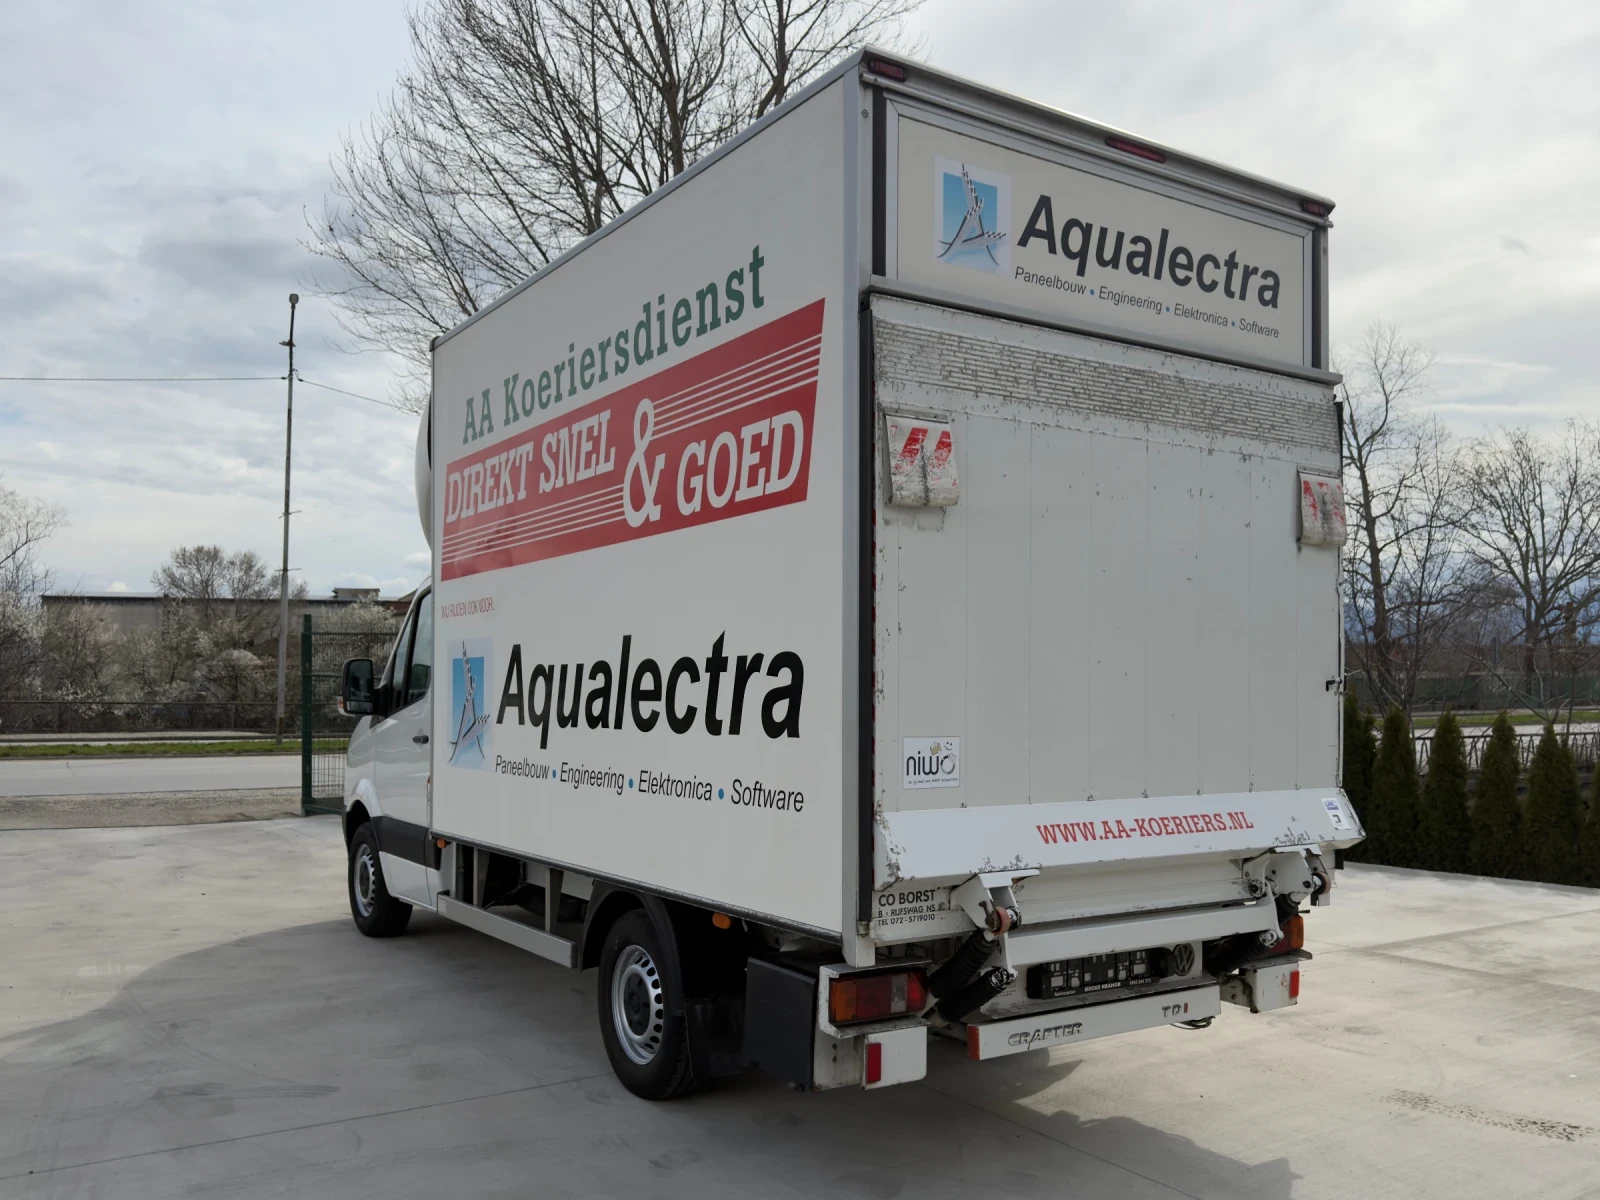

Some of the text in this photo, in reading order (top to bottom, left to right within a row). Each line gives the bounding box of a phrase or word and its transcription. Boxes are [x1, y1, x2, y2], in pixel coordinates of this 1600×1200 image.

[1017, 194, 1281, 310] Aqualectra
[1015, 266, 1280, 339] Paneelbouw Engineering Elektronica Software
[463, 243, 765, 445] AA Koeriersdienst
[446, 398, 804, 528] DIREKT SNEL & GOED
[467, 600, 479, 615] OOK
[496, 630, 804, 750] Aqualectra
[495, 754, 804, 813] Paneelbouw Engineering Elektronica Software
[1036, 811, 1255, 845] WWW.AA-KOERIERS.NL
[878, 889, 936, 907] CO BORST
[878, 918, 889, 926] TEL
[1161, 1002, 1189, 1018] TDI
[1008, 1022, 1083, 1047] CRAFTER
